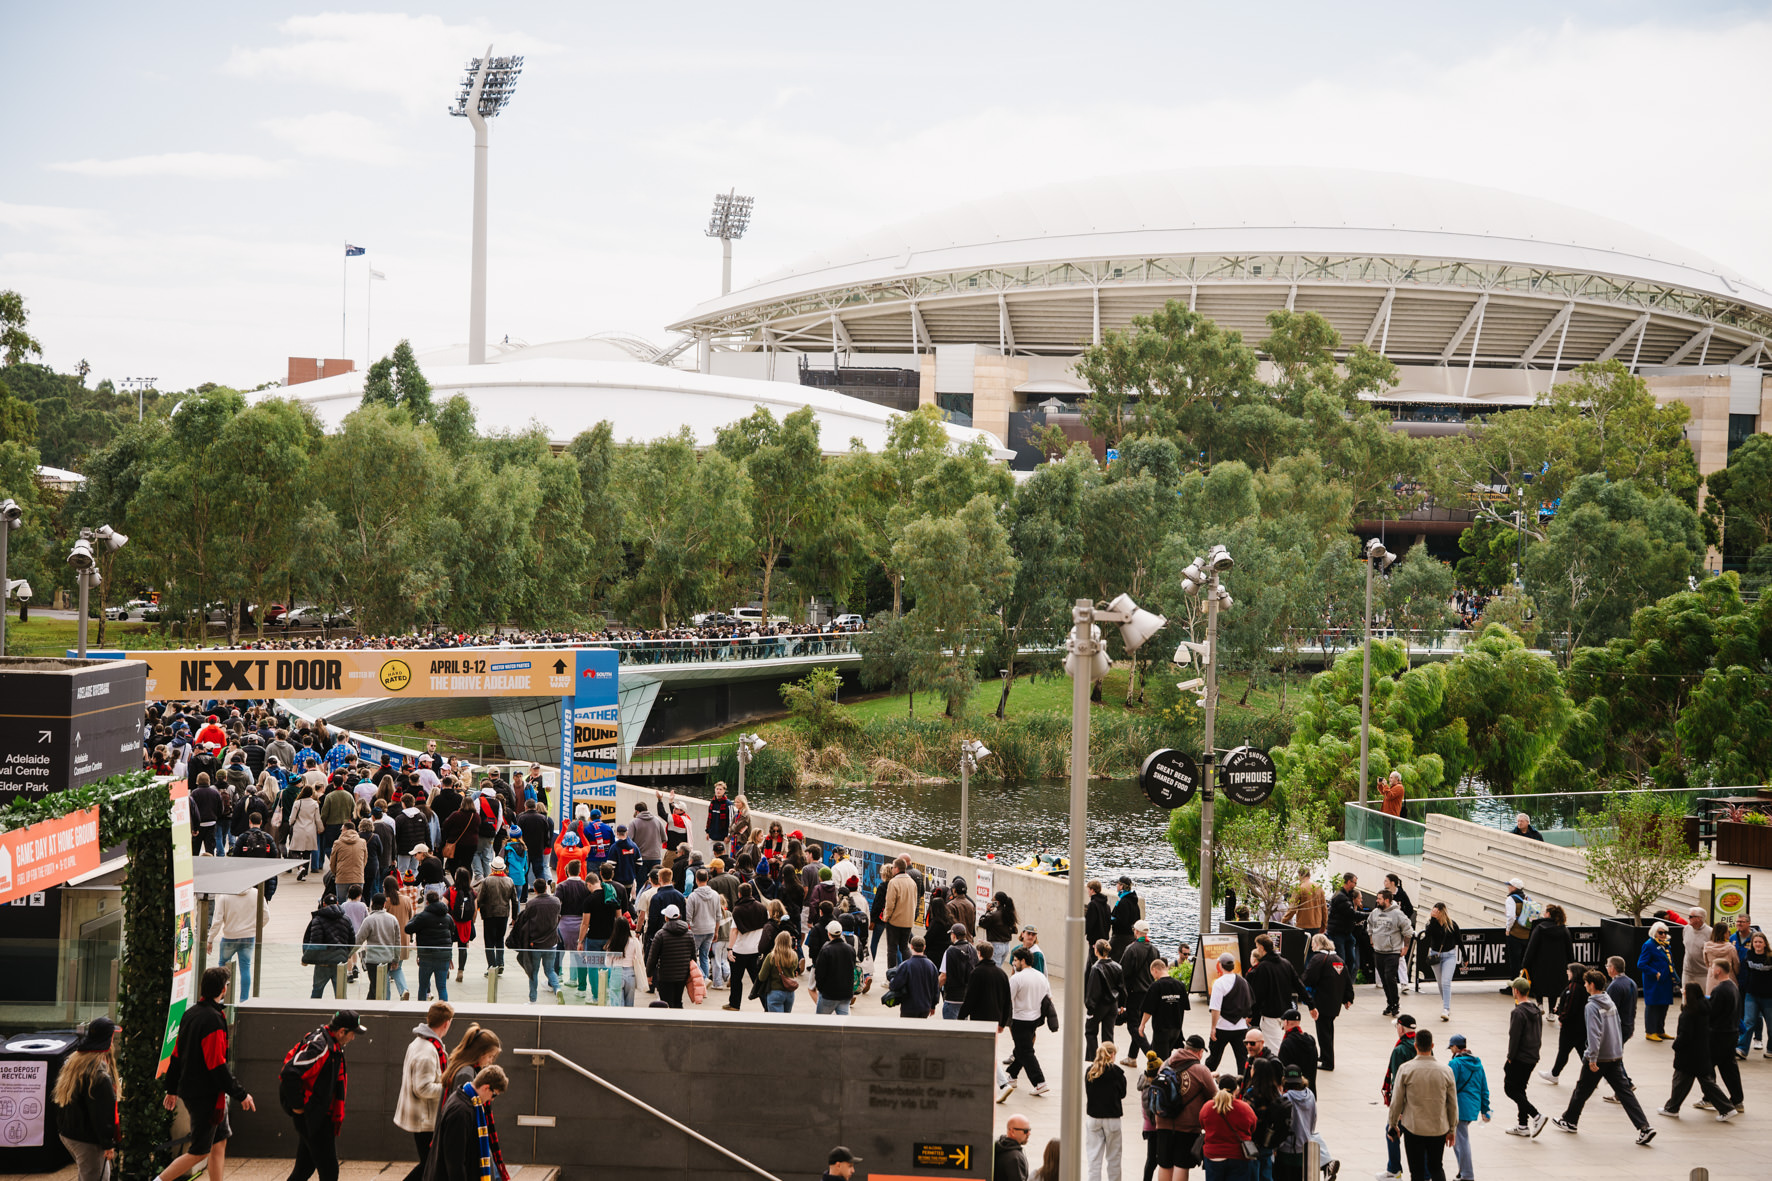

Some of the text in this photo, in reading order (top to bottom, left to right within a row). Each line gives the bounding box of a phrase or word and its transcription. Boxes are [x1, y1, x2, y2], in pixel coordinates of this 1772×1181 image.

[430, 660, 486, 674] APRIL 9-12
[180, 659, 342, 691] NEXT DOOR
[384, 675, 408, 685] RATED
[430, 675, 531, 690] THE DRIVE ADELAIDE
[574, 708, 618, 721] GATHER
[564, 709, 572, 767] GATHER
[574, 725, 618, 744] ROUND
[5, 753, 50, 764] Adelaide
[574, 747, 617, 760] GATHER
[1233, 751, 1269, 766] MALT SHOVEL
[15, 766, 50, 776] Centre
[573, 764, 617, 783] ROUND
[1156, 763, 1192, 784] GREAT BEERS
[1229, 771, 1273, 785] TAPHOUSE
[25, 782, 49, 792] Park
[1153, 771, 1189, 792] SHARED FOOD
[573, 784, 617, 797] GATHER
[16, 820, 97, 868] GAME DAY AT HOME GROUND
[1483, 943, 1506, 964] AVE
[869, 1084, 975, 1099] Riverbank Car Park
[869, 1096, 939, 1111] Entry via Lift
